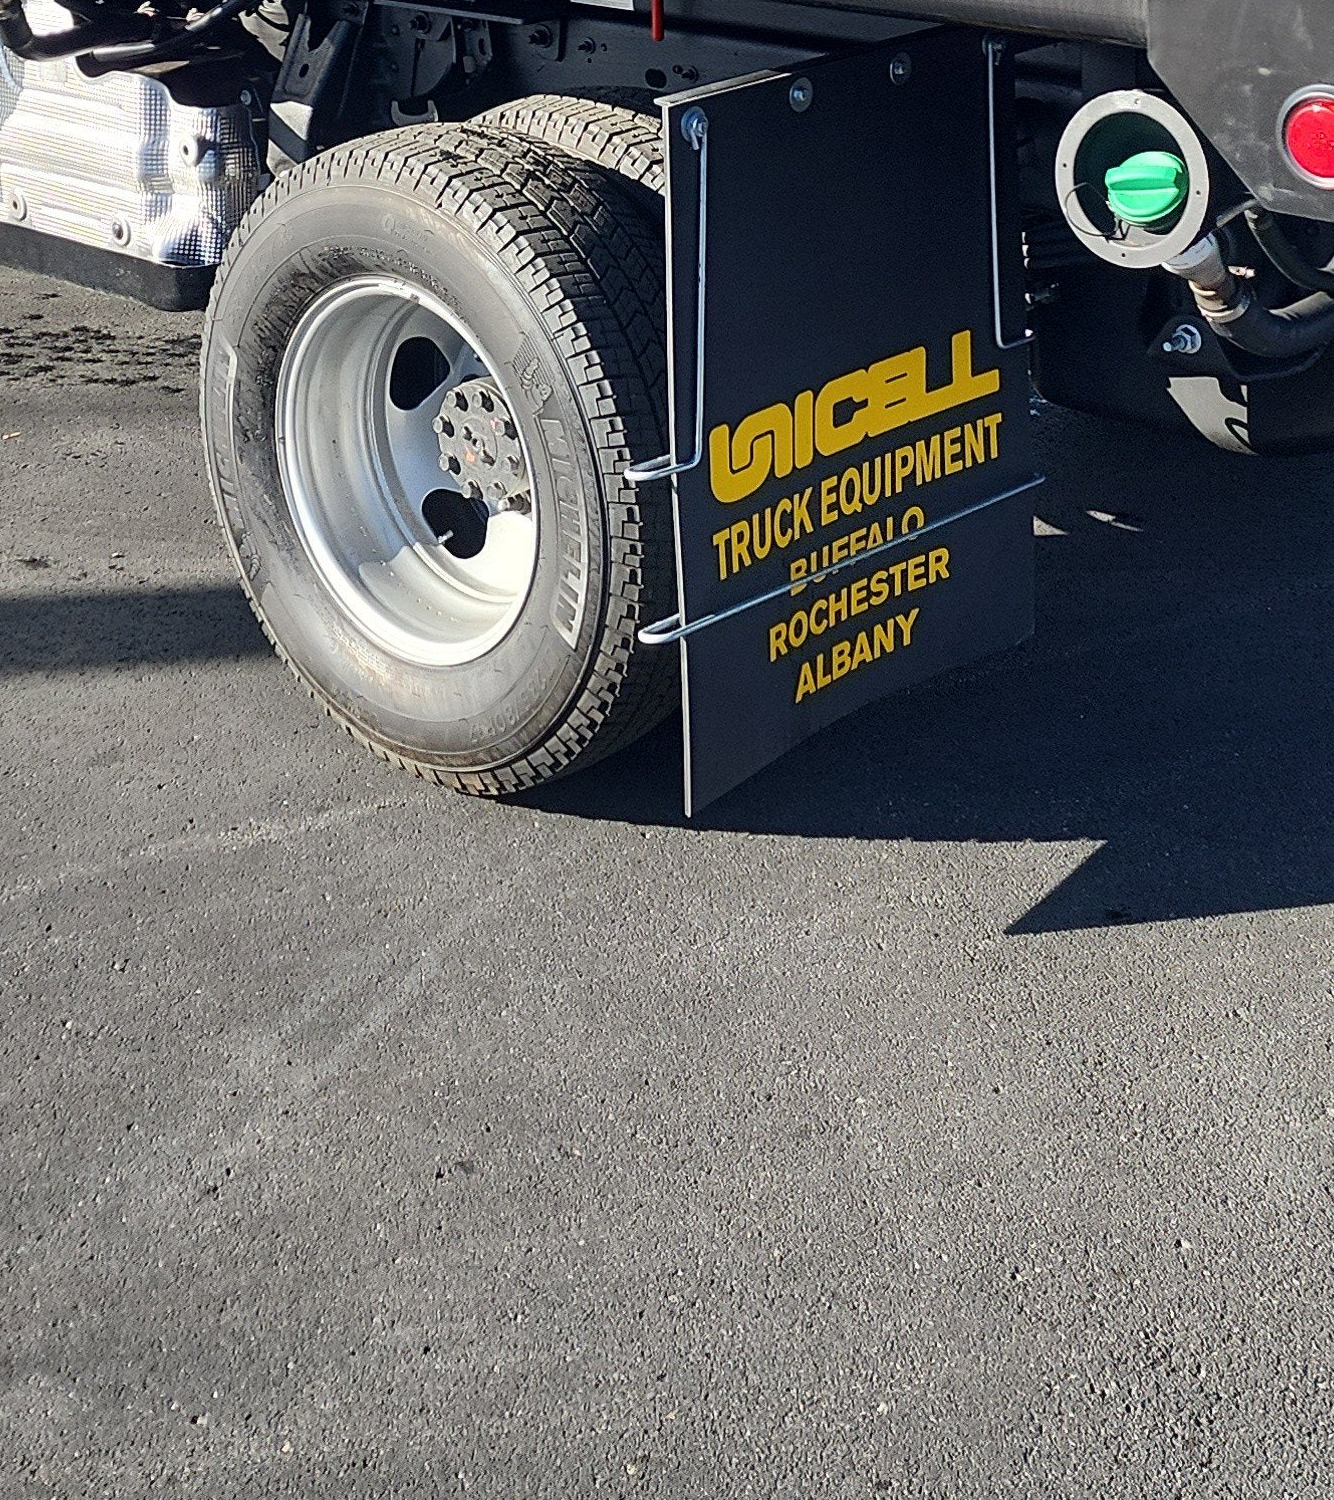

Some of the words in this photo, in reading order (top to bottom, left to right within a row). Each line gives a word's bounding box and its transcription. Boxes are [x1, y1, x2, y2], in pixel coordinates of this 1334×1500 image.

[709, 329, 1000, 504] UNICELL
[712, 485, 814, 581] TRUCK
[820, 412, 1003, 526] EQUIPMENT
[539, 418, 582, 635] MICHELIN
[769, 547, 951, 662] ROCHESTER
[794, 608, 919, 703] ALBANY
